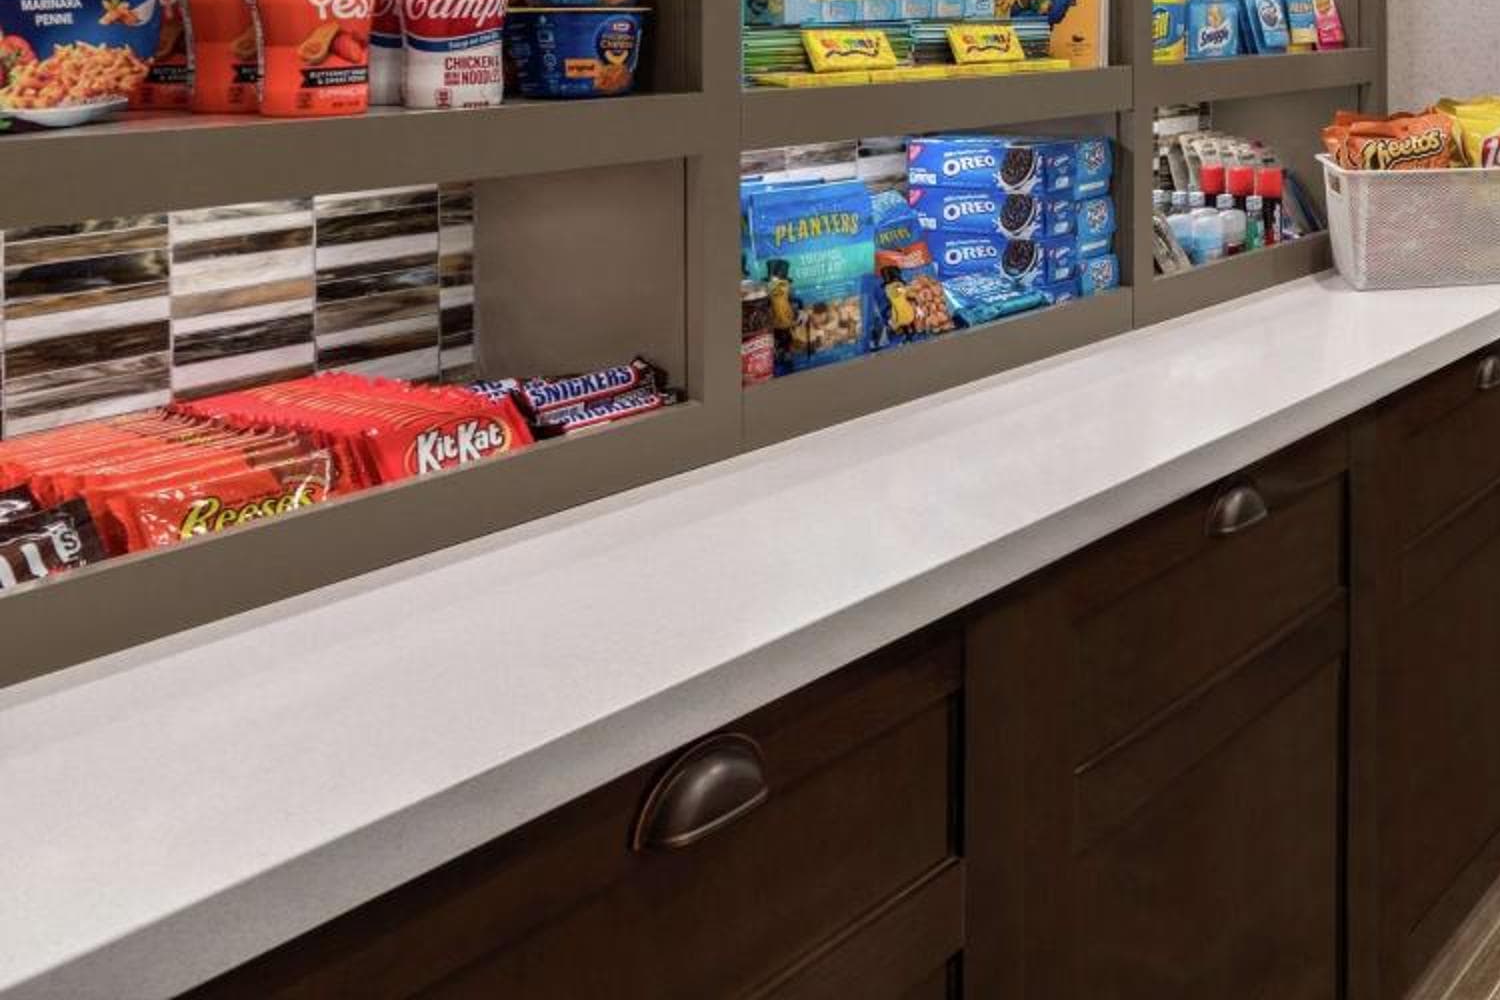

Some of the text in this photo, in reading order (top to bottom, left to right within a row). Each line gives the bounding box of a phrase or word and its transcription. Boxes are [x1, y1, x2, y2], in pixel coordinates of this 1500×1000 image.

[35, 12, 74, 27] PENNE
[1362, 128, 1444, 170] Cheetos
[943, 153, 996, 177] OREO
[943, 198, 996, 222] OREO
[774, 212, 861, 248] PLANTERS
[944, 246, 998, 267] OREO
[532, 366, 634, 408] SNICKERS
